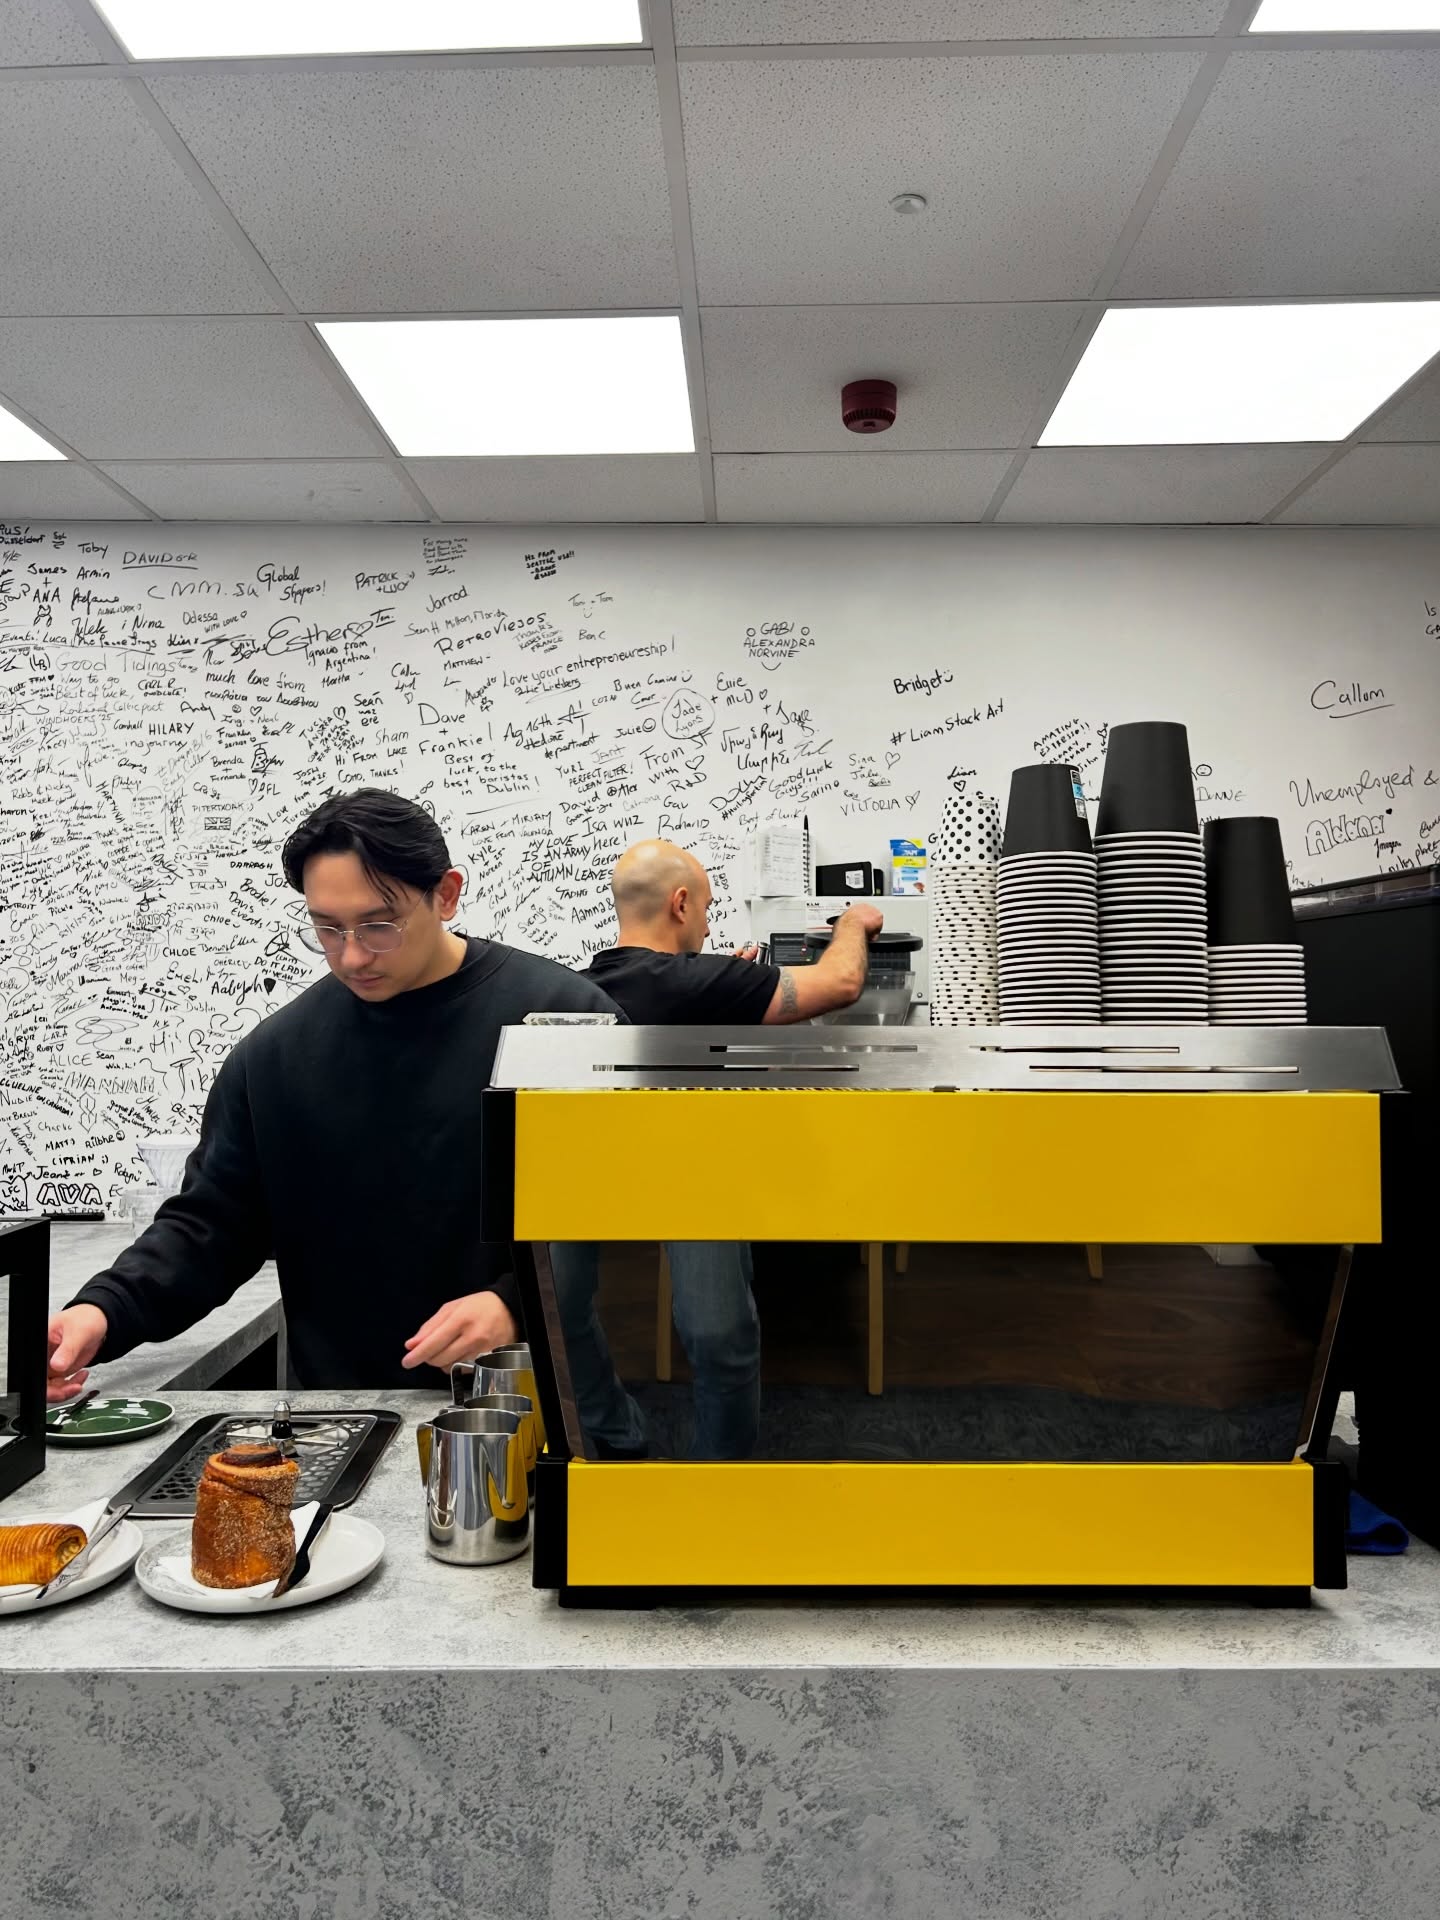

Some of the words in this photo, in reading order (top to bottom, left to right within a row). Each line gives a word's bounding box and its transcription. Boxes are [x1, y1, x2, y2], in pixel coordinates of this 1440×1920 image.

[78, 542, 109, 559] Toby
[27, 562, 67, 575] James
[76, 566, 110, 581] Armin
[257, 563, 300, 591] Global
[426, 584, 470, 613] Jarrod
[183, 611, 218, 626] Odessa
[760, 621, 795, 635] GABI
[343, 639, 368, 652] from
[743, 637, 815, 648] ALEXANDRA
[56, 651, 107, 671] Good
[116, 650, 177, 677] Tidings
[88, 674, 99, 686] to
[205, 668, 236, 685] much
[247, 667, 270, 687] love
[502, 671, 529, 688] Love
[532, 665, 562, 686] your
[893, 669, 943, 696] Bridget
[613, 678, 641, 692] Buen
[418, 702, 466, 726] Dave
[911, 727, 944, 742] Liam
[945, 708, 981, 731] Stack
[986, 697, 1004, 720] Art
[149, 722, 194, 735] HILARY
[353, 751, 377, 764] FROM
[445, 754, 474, 765] Best
[499, 762, 517, 771] the
[444, 777, 469, 788] best
[479, 771, 529, 783] baristas
[569, 768, 602, 787] PERFECT
[1289, 765, 1415, 807] Unemployed
[529, 837, 545, 850] MY
[547, 833, 579, 849] LOVE
[522, 850, 540, 863] IS
[543, 848, 562, 861] AN
[563, 845, 592, 861] ARMY
[526, 862, 574, 883] AUTUMN
[575, 869, 613, 881] LEAVES
[531, 861, 551, 872] OF
[163, 946, 197, 957] CHLOE
[711, 939, 735, 951] Luca
[48, 1052, 93, 1067] ALICE
[52, 1153, 95, 1166] CIPRIAN
[36, 1182, 103, 1206] AVA
